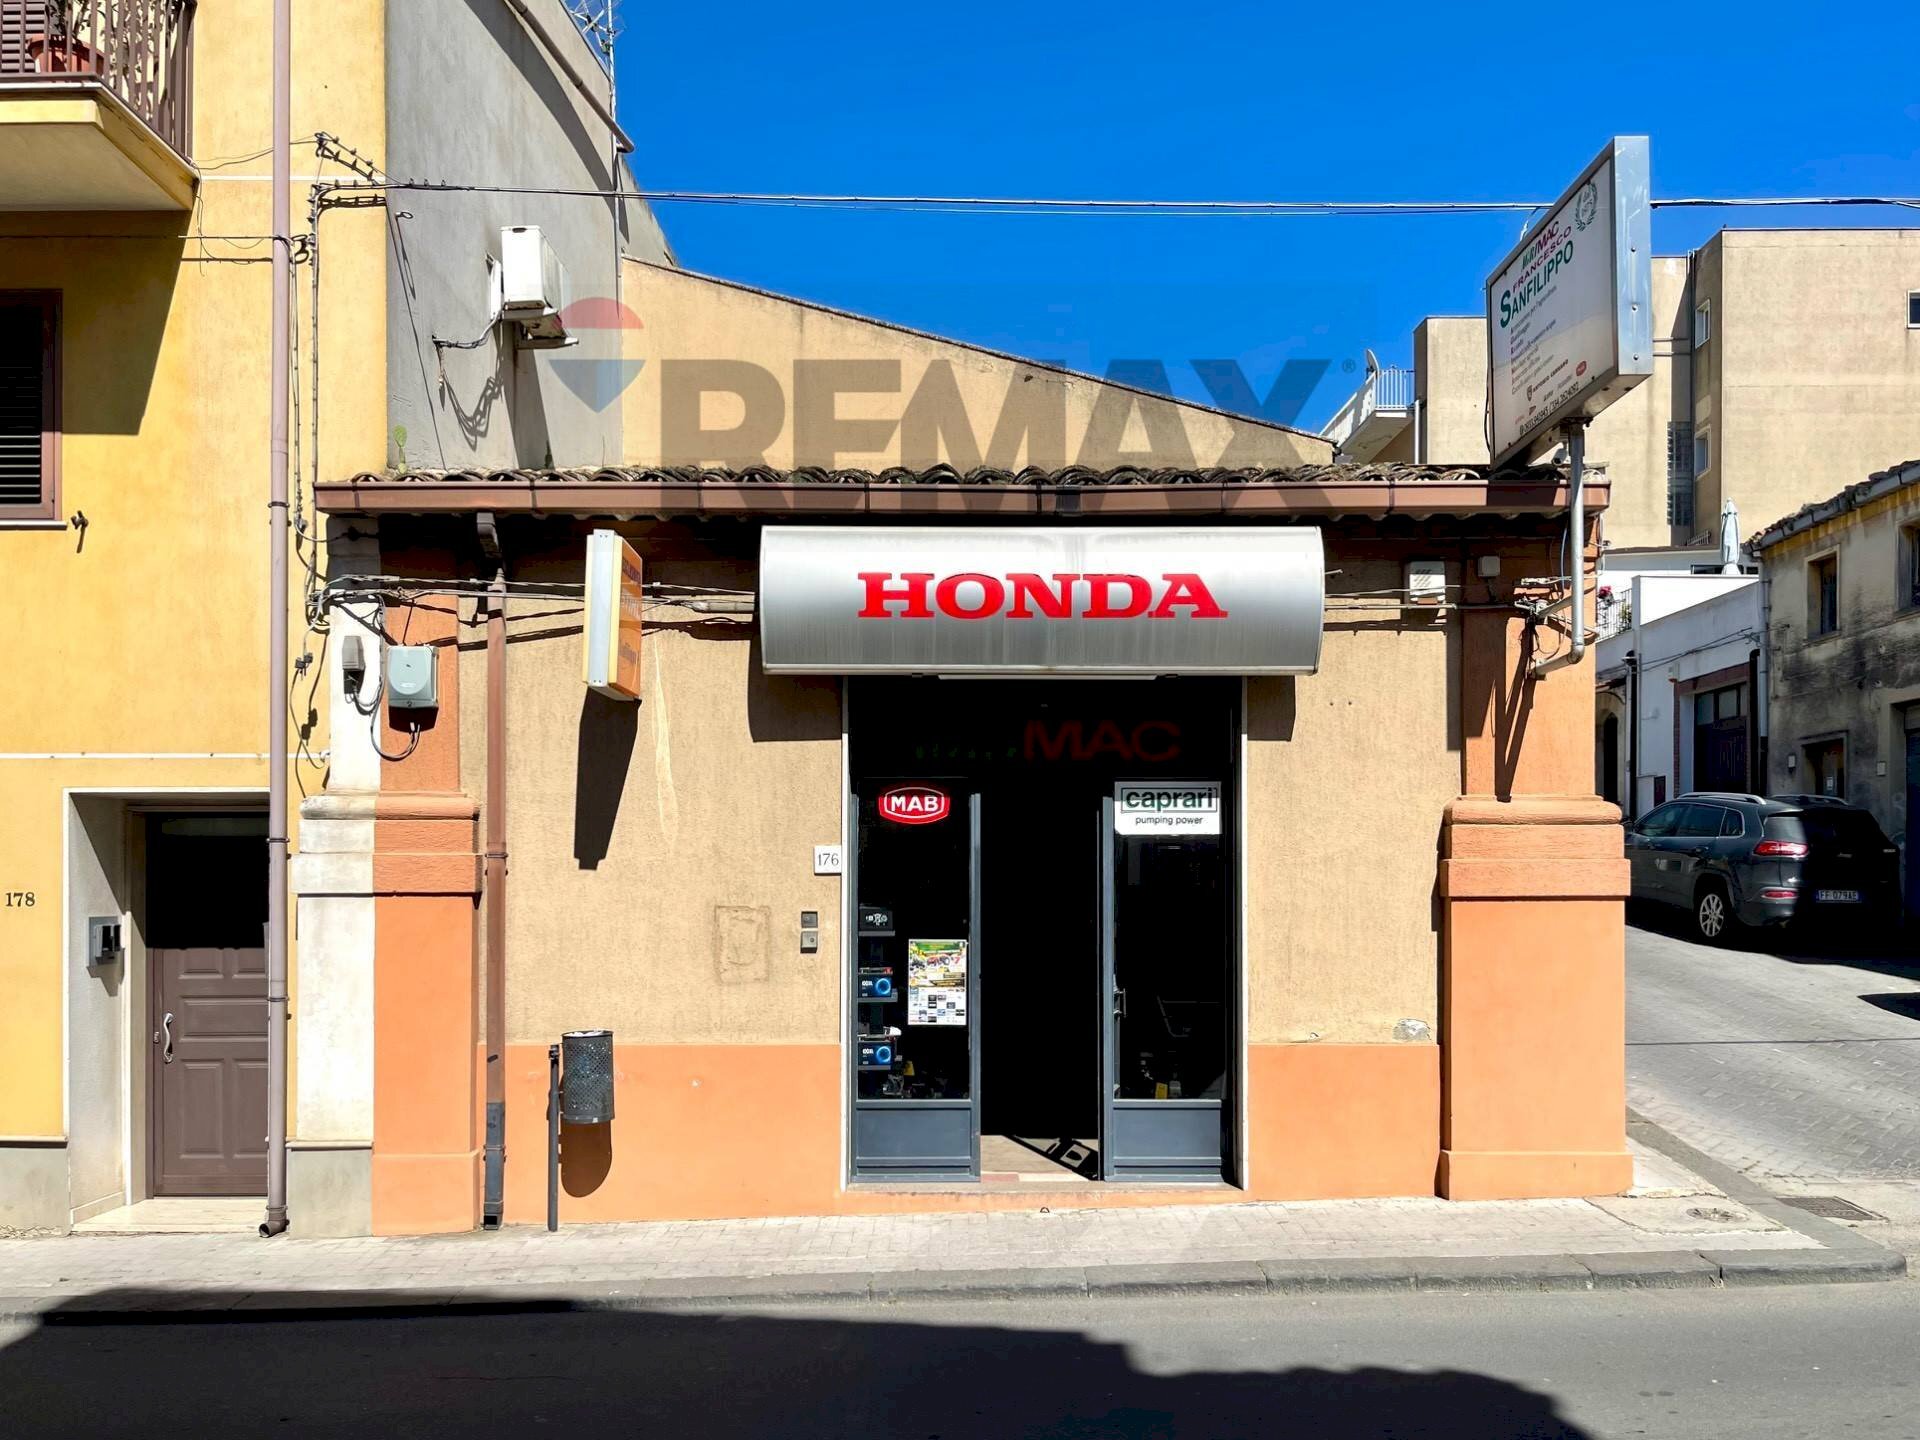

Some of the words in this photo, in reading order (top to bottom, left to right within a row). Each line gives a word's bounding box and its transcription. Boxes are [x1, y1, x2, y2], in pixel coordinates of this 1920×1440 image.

[1513, 226, 1572, 293] FRANCESCO
[1500, 240, 1573, 328] SANFILIPPO
[857, 573, 1229, 619] HONDA
[1023, 719, 1181, 762] MAC
[891, 795, 939, 812] MAB
[1126, 787, 1213, 812] caprari
[1135, 816, 1173, 826] pumping
[1176, 817, 1203, 825] power
[818, 853, 839, 866] 176
[5, 892, 35, 907] 178
